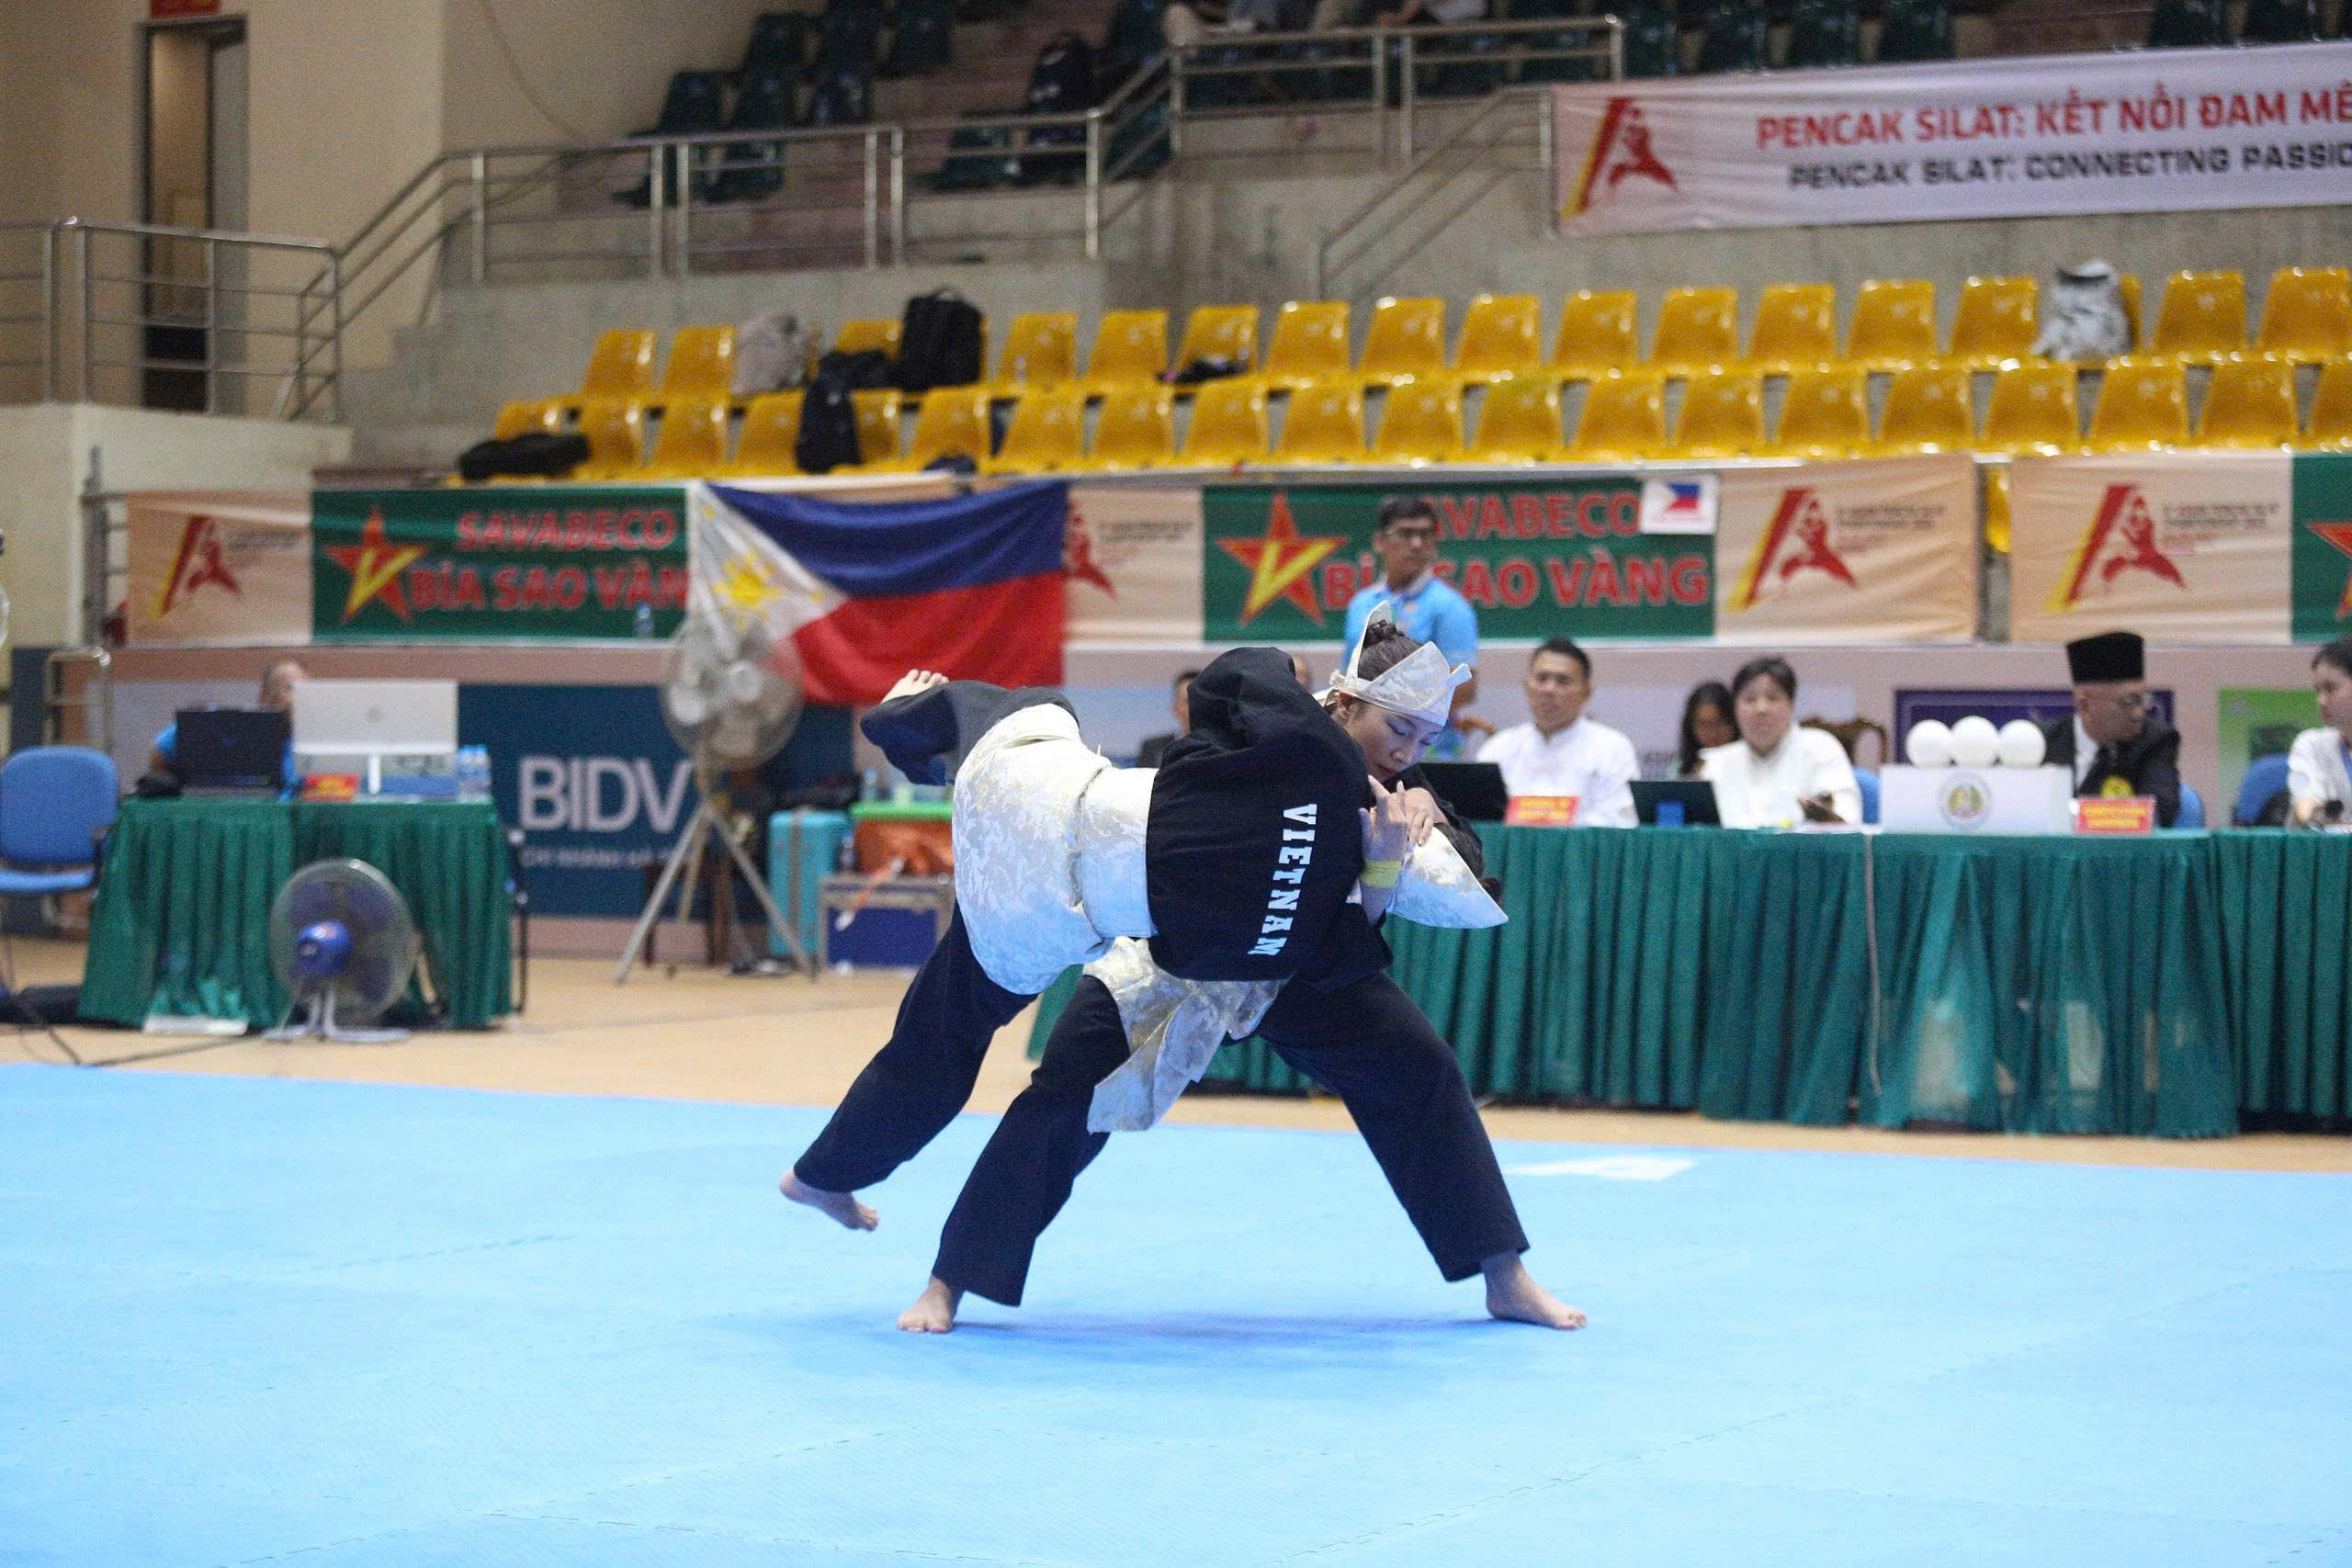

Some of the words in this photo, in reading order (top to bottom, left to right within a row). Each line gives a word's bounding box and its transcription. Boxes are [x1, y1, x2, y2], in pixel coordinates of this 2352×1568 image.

[1756, 111, 1904, 150] PENCAK
[1916, 104, 2024, 142] SILAT:
[2198, 92, 2288, 128] ĐAM
[1790, 161, 1909, 189] PENCAK
[2025, 148, 2232, 181] CONNECTING
[458, 508, 676, 551] SAVABECO
[1420, 492, 1642, 542] VABECO
[492, 566, 587, 610] SAO
[594, 557, 690, 611] VÀN
[1548, 546, 1710, 607] VÀNG
[519, 755, 695, 834] BIDV
[1247, 803, 1318, 956] VIETNAM
